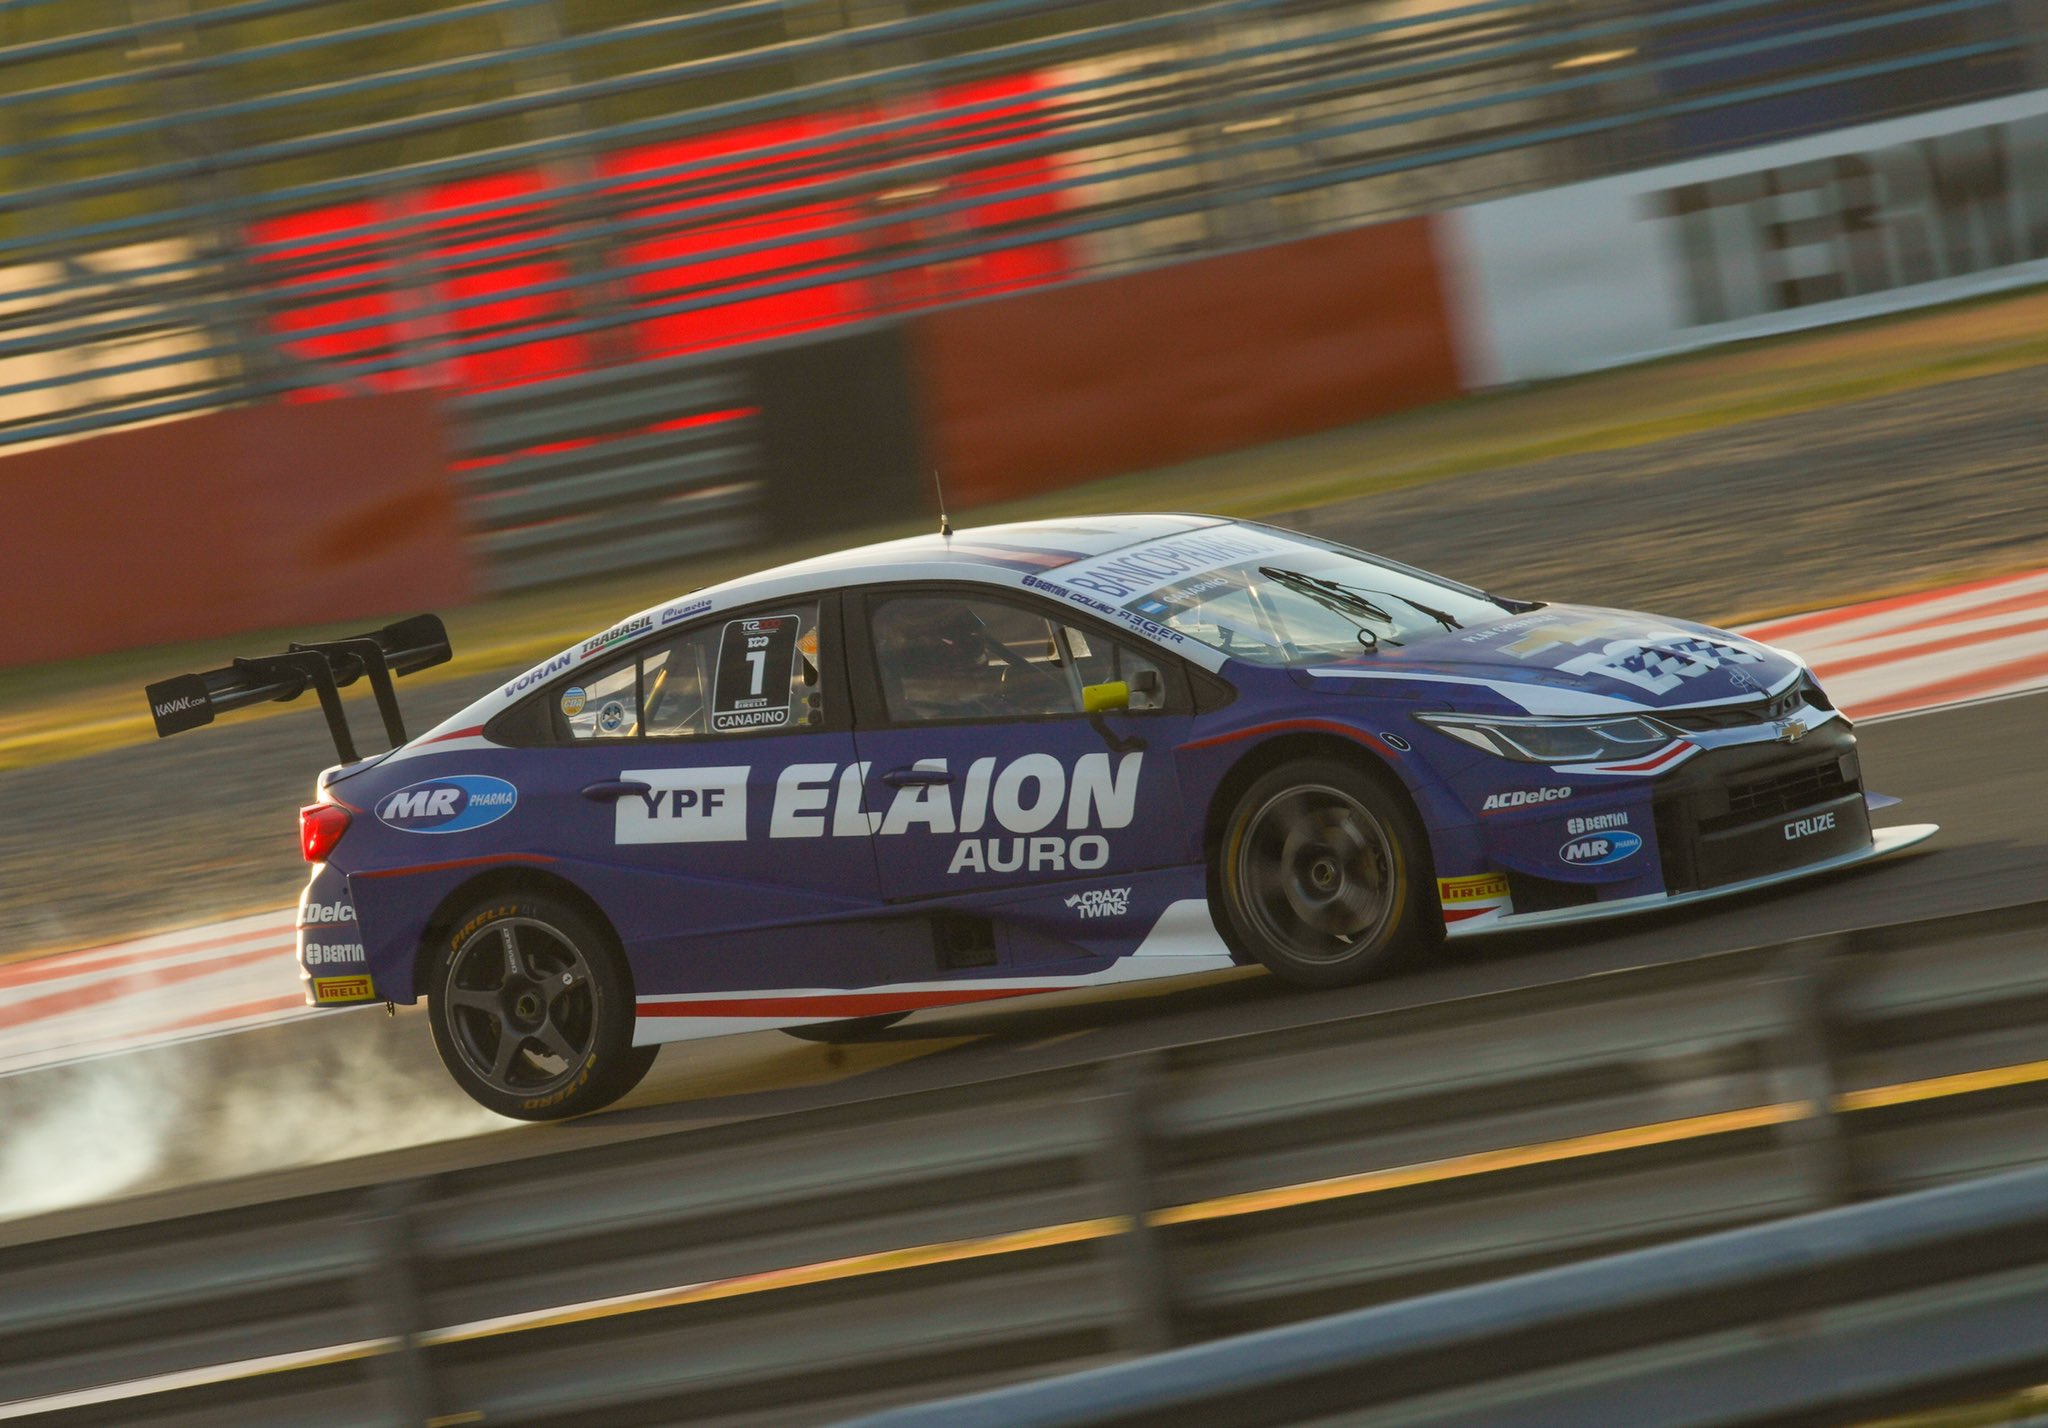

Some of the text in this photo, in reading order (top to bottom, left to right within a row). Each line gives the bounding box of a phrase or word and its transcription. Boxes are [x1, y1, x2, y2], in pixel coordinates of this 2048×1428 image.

[1034, 580, 1068, 598] BERTINI
[1162, 577, 1228, 604] CANAPINO
[1070, 593, 1116, 615] COLLINO
[582, 616, 653, 653] TRABASIL
[504, 653, 572, 698] VORAN
[745, 650, 766, 695] 1
[734, 698, 768, 709] PIRELLI
[717, 710, 785, 727] CANAPINO
[382, 787, 513, 820] MR PHARMA
[640, 788, 725, 818] YPF
[769, 751, 1143, 838] ELAION
[1482, 786, 1571, 811] ACDelco
[1585, 811, 1629, 831] BERTINI
[1784, 811, 1836, 840] CRUZE
[947, 834, 1110, 873] AURO
[1566, 838, 1639, 860] MR PHARMA
[1081, 887, 1132, 905] CRAZY
[1442, 875, 1507, 899] PIRELLI
[1078, 901, 1128, 919] TWINS
[450, 905, 518, 951] PIRELLI
[317, 979, 369, 998] PIRELLI
